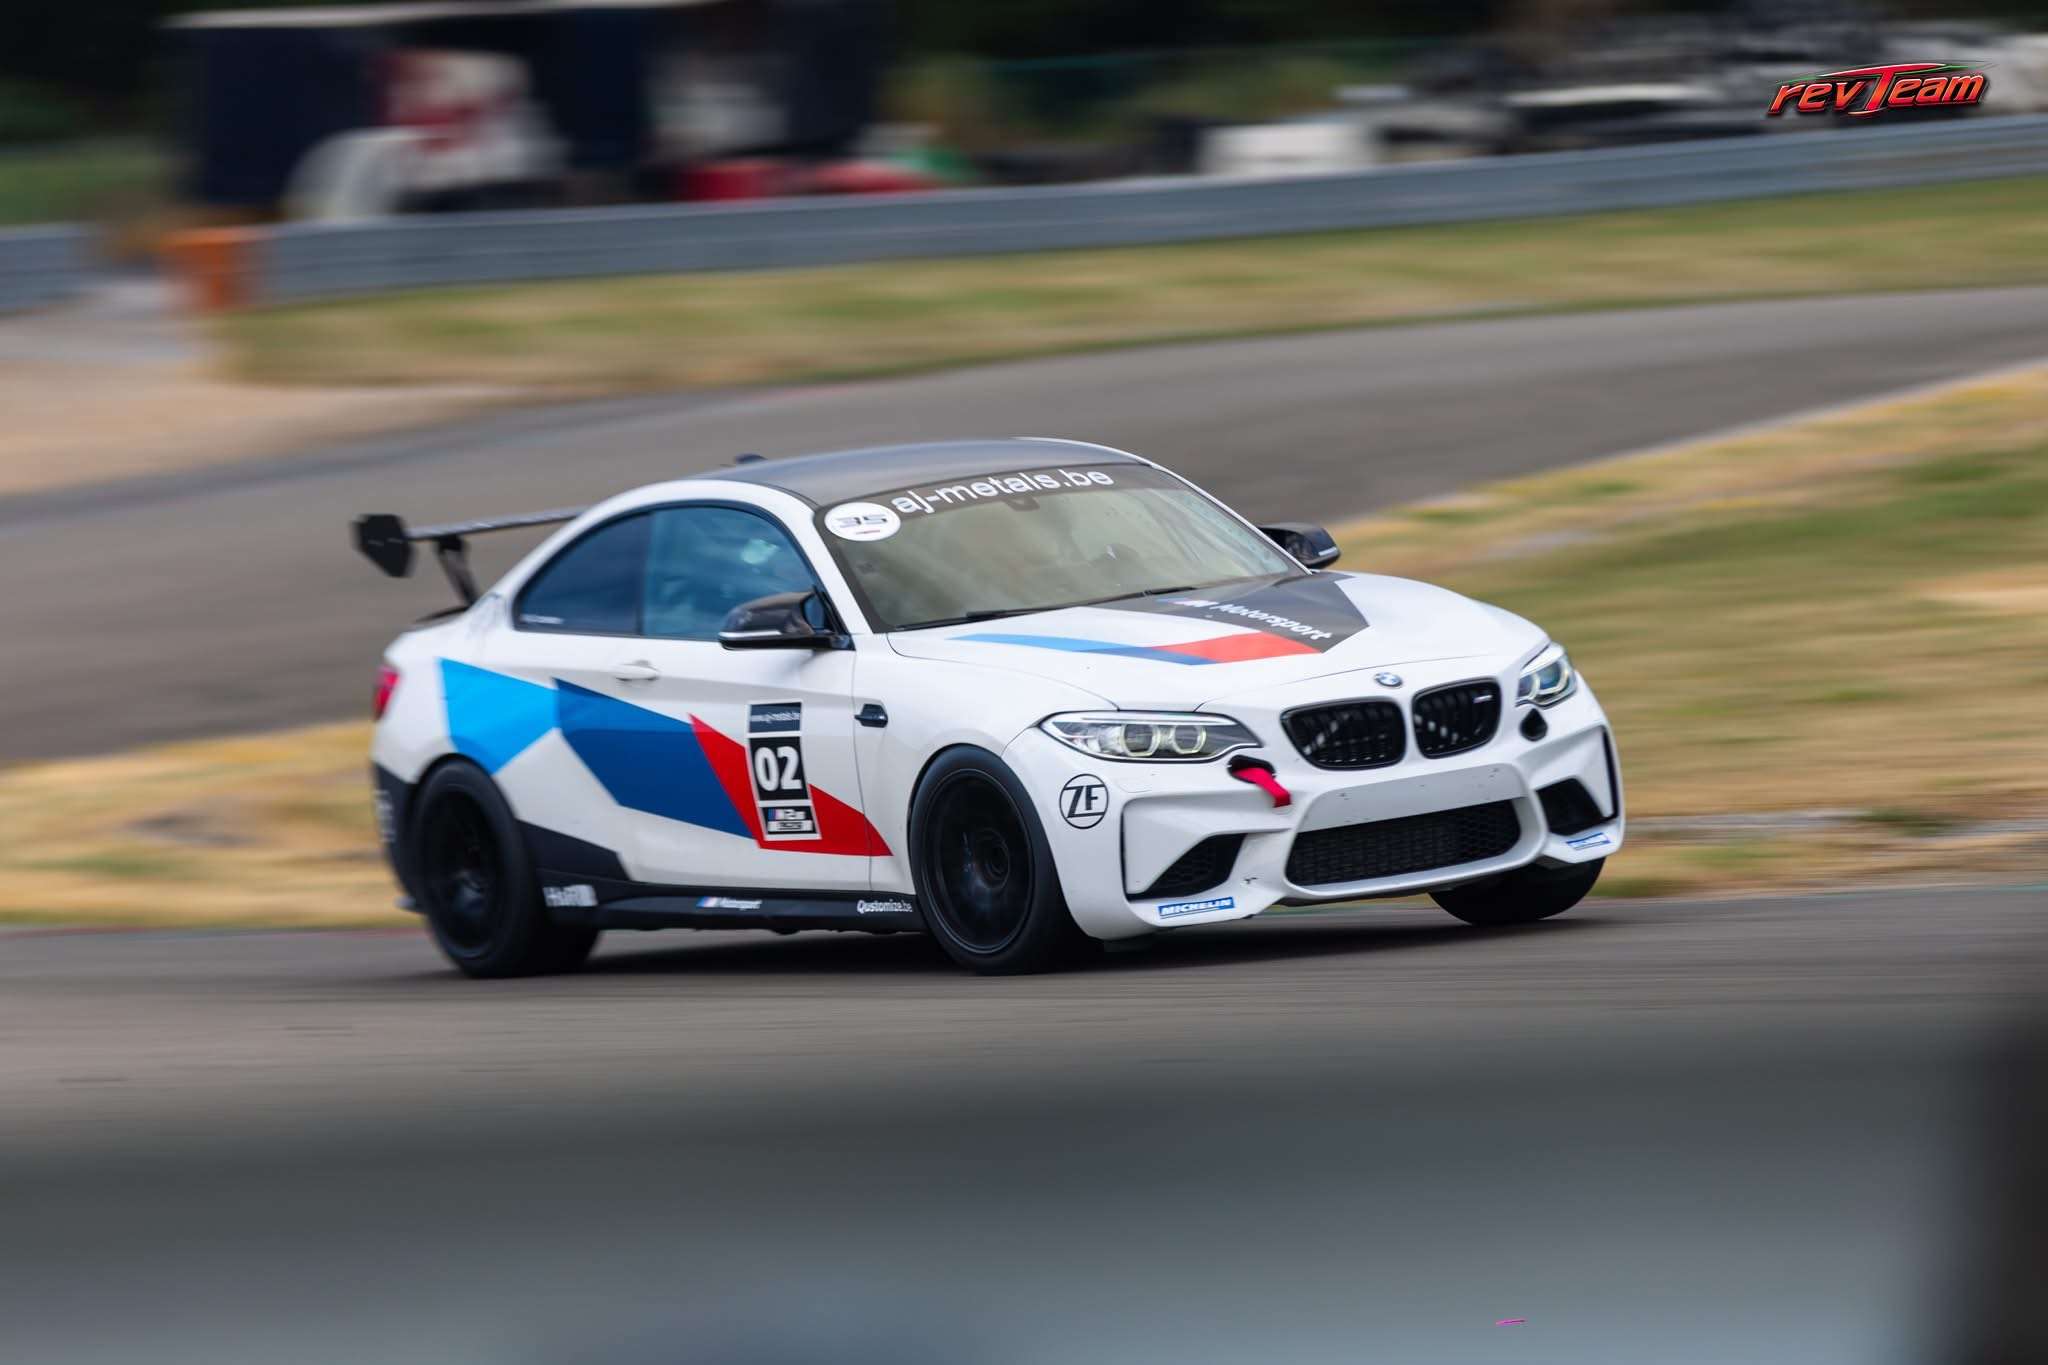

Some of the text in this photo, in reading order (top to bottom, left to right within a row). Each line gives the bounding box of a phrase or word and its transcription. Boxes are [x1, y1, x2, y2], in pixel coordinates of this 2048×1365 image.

[891, 469, 1114, 513] aj-metals.be
[1211, 603, 1332, 640] Motorsport
[754, 745, 803, 791] 02
[1063, 784, 1105, 818] ZF
[1161, 900, 1232, 916] MICHELIN
